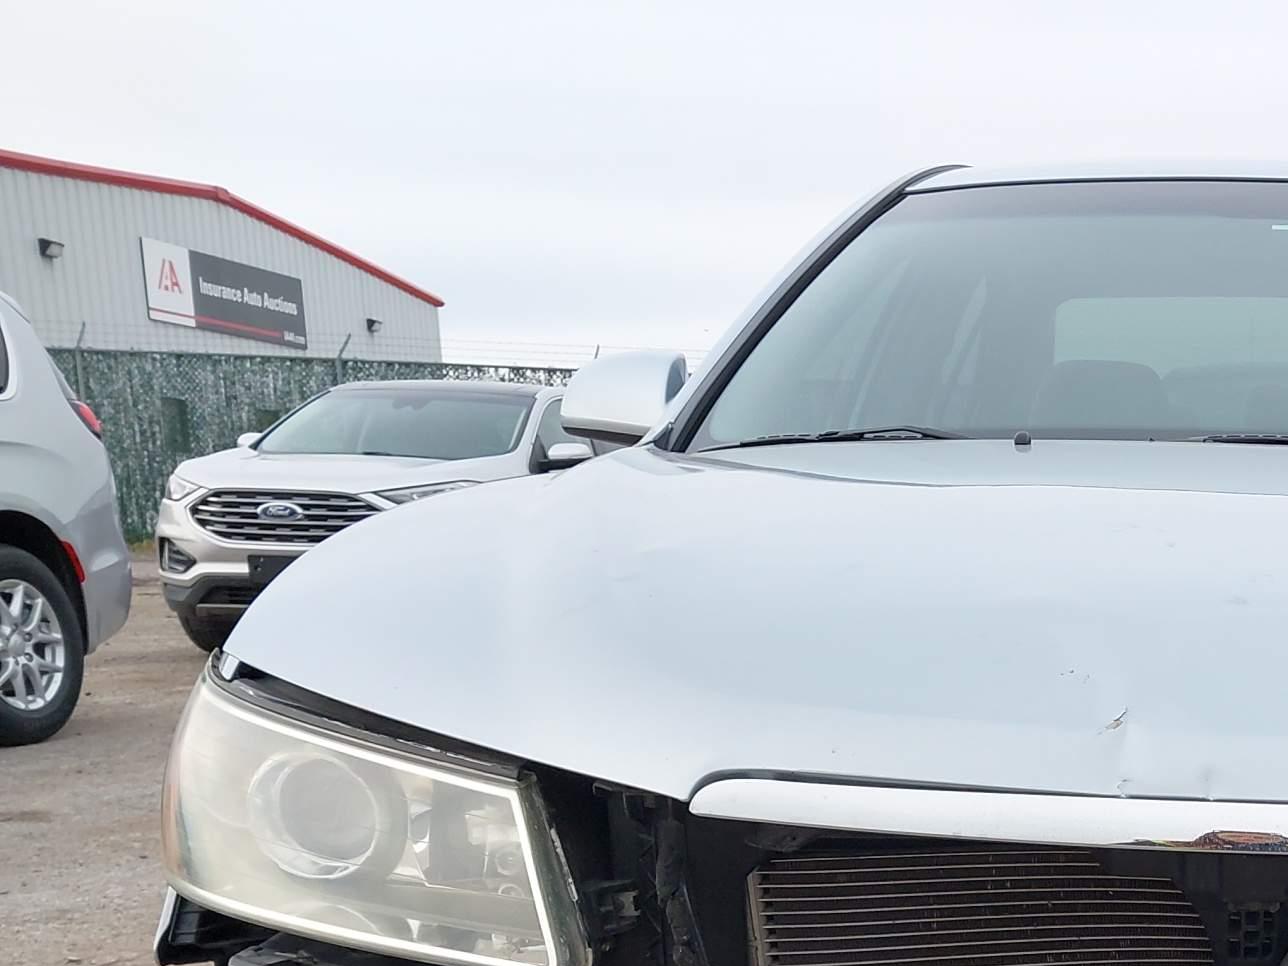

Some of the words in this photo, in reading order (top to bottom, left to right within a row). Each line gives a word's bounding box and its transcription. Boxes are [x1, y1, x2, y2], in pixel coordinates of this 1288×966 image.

[199, 276, 242, 303] Insurance
[243, 287, 262, 308] Auto
[263, 292, 298, 316] Auctions
